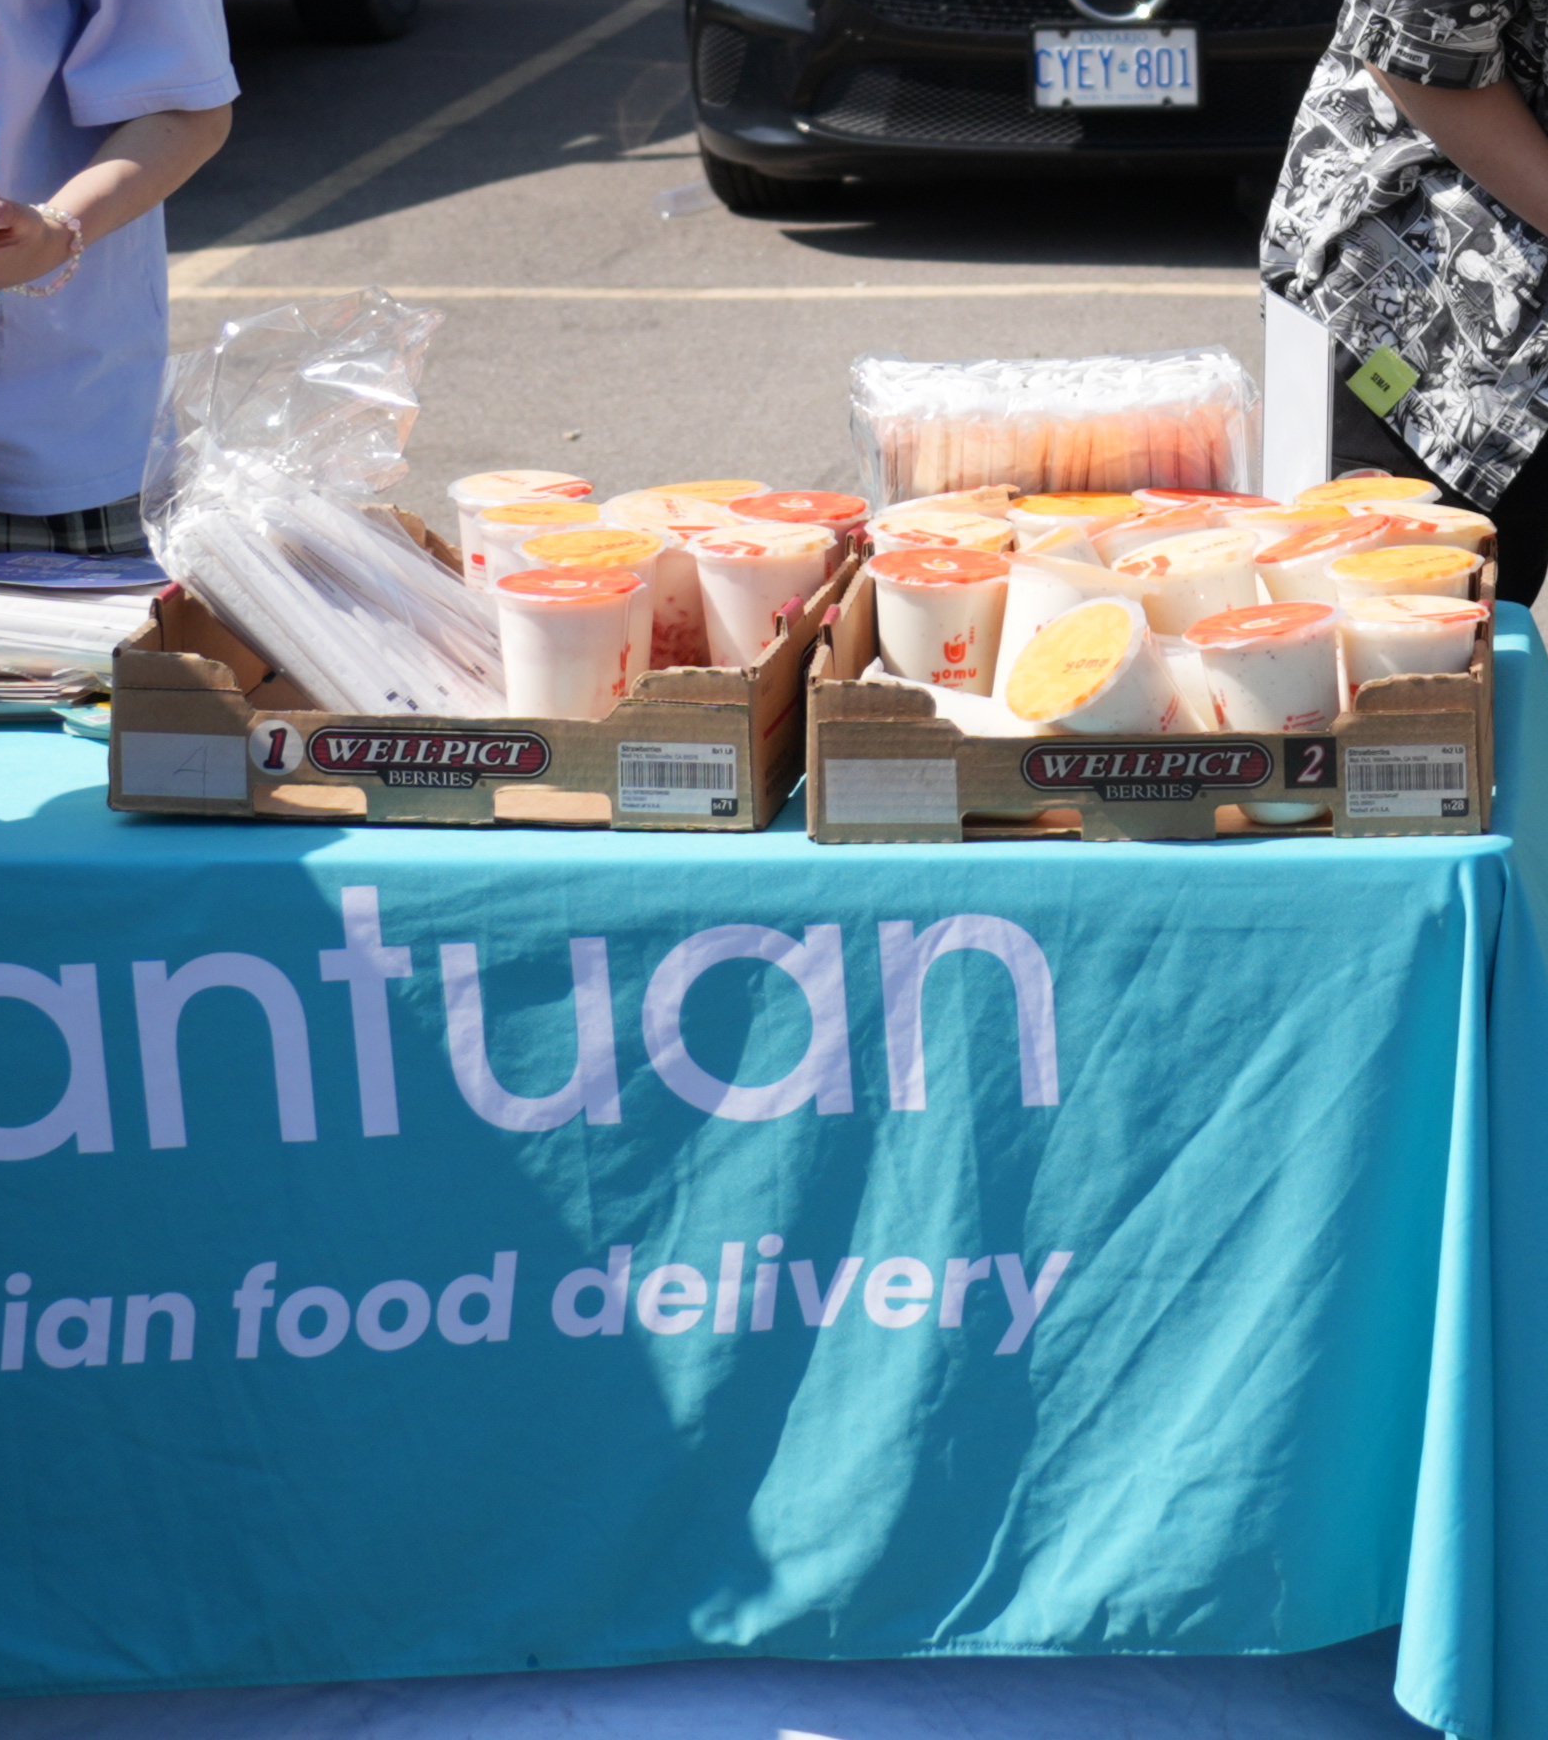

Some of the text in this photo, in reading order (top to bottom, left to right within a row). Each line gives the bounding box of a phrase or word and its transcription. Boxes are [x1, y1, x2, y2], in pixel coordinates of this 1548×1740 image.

[1035, 47, 1191, 89] CYEY 801
[931, 667, 977, 684] yomu
[262, 726, 288, 770] 1
[1296, 743, 1327, 784] 2
[388, 769, 474, 787] BERRIES
[1105, 783, 1194, 800] BERRIES
[232, 1248, 517, 1361] food
[551, 1232, 1074, 1354] delivery
